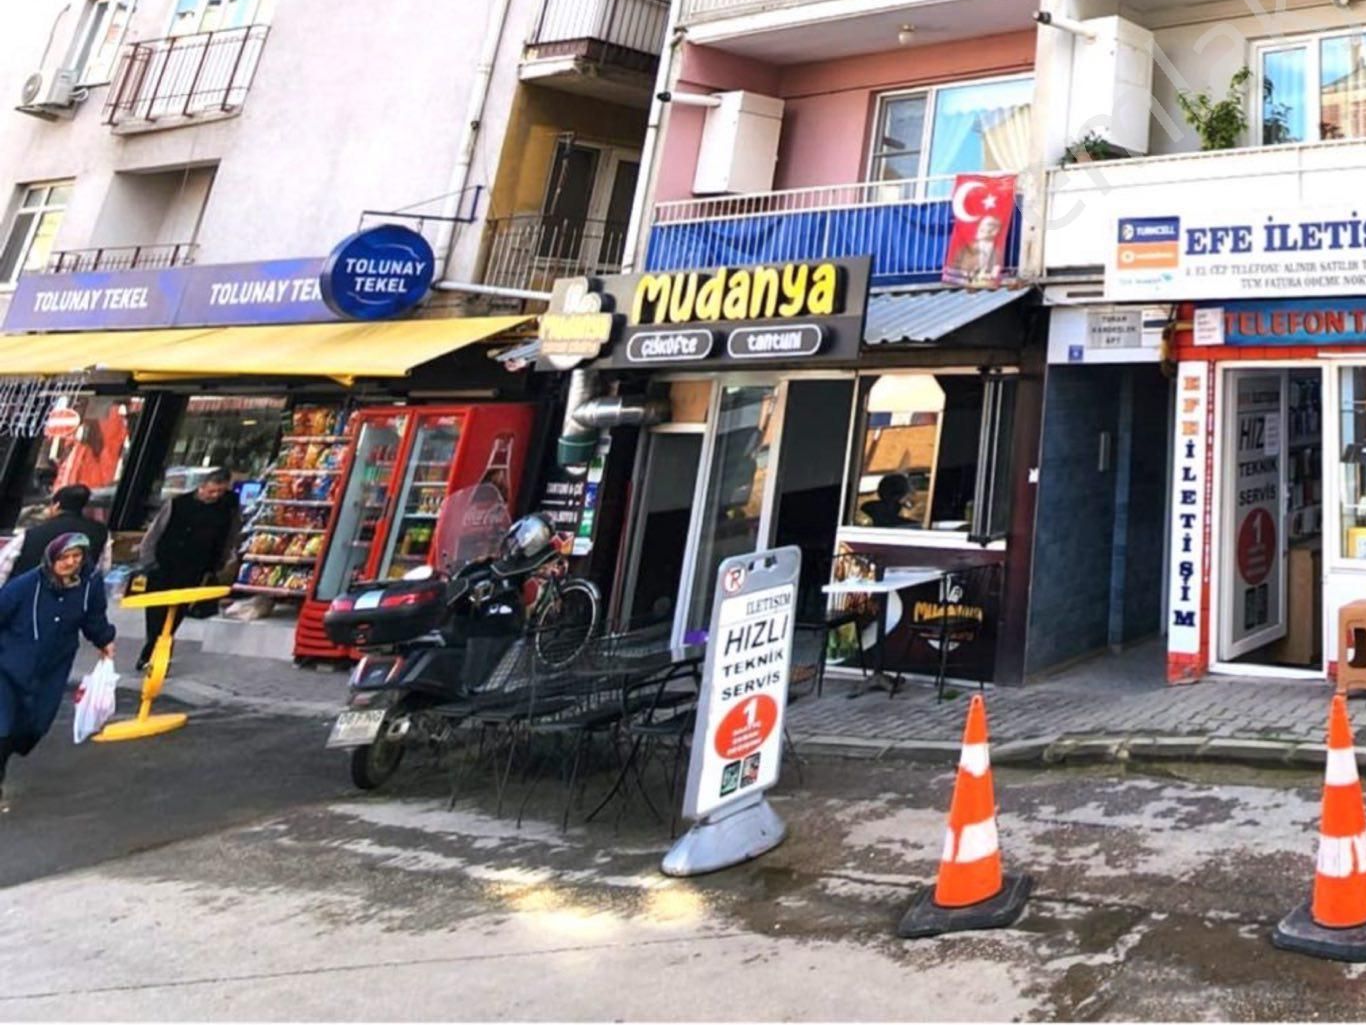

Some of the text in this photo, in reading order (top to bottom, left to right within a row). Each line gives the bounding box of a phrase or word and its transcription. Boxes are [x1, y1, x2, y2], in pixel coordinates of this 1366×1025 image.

[1185, 225, 1253, 256] EFE
[345, 257, 426, 276] TOLUNAY
[33, 286, 149, 313] TOLUNAY TEKEL
[209, 277, 322, 305] TOLUNAY TEK
[354, 276, 408, 294] TEKEL
[1224, 309, 1345, 337] TELEFON
[1239, 416, 1265, 451] HIZ
[723, 613, 789, 657] HIZLI
[722, 648, 784, 678] TEKNİK
[721, 670, 781, 701] SERVİS
[743, 698, 758, 729] 1
